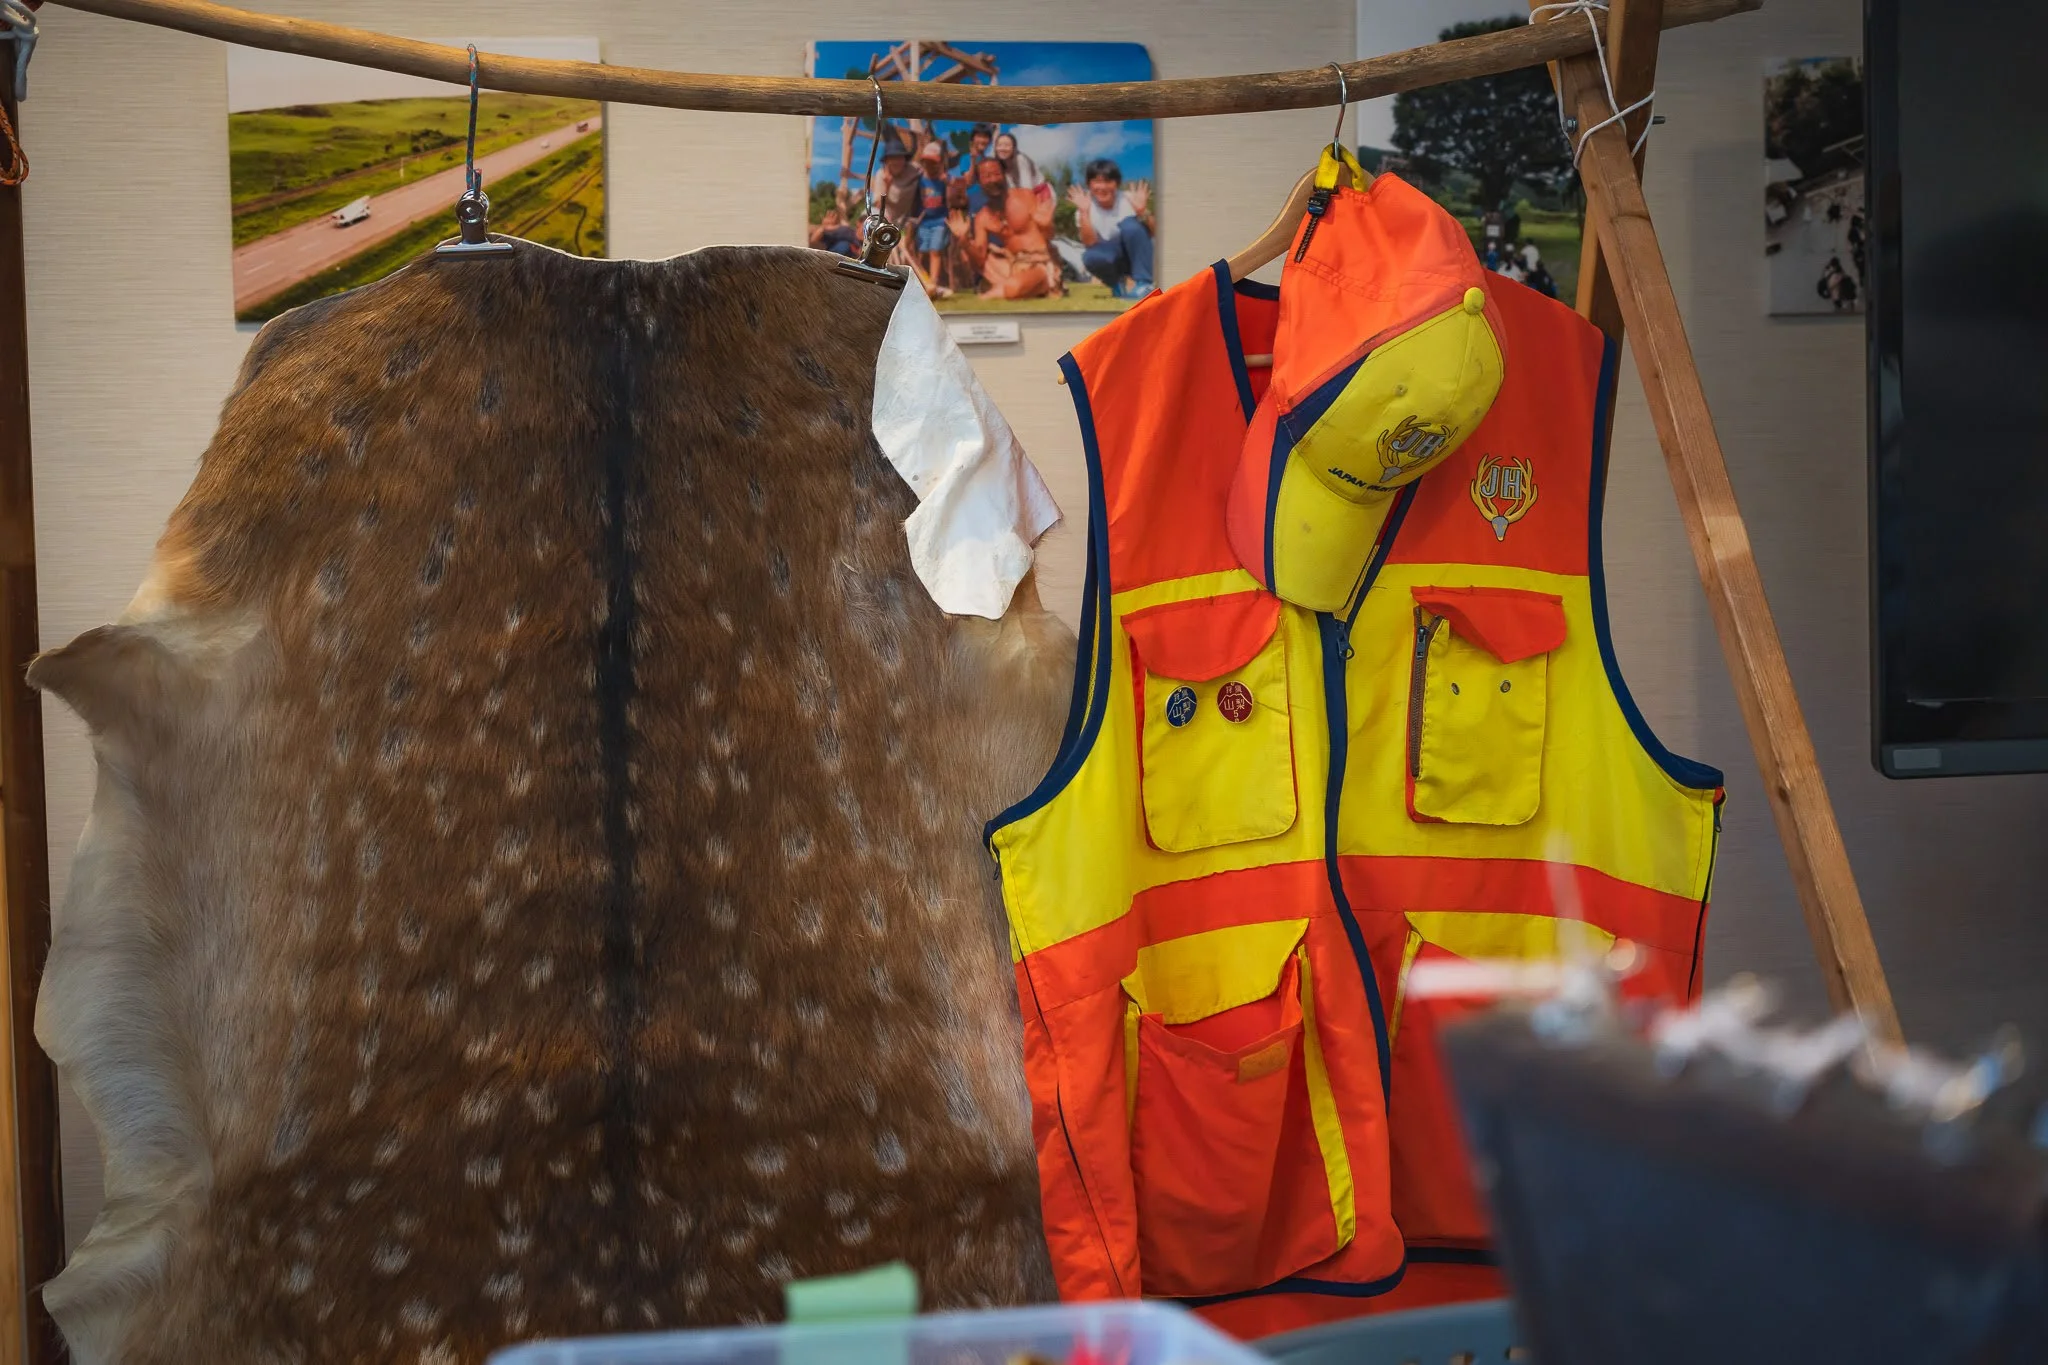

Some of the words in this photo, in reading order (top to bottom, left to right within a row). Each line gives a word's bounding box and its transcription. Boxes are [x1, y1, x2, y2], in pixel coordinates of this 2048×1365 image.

[1391, 430, 1446, 458] JH
[1328, 467, 1367, 487] JAPAN
[1481, 466, 1522, 498] JH
[1223, 698, 1245, 710] 山梨
